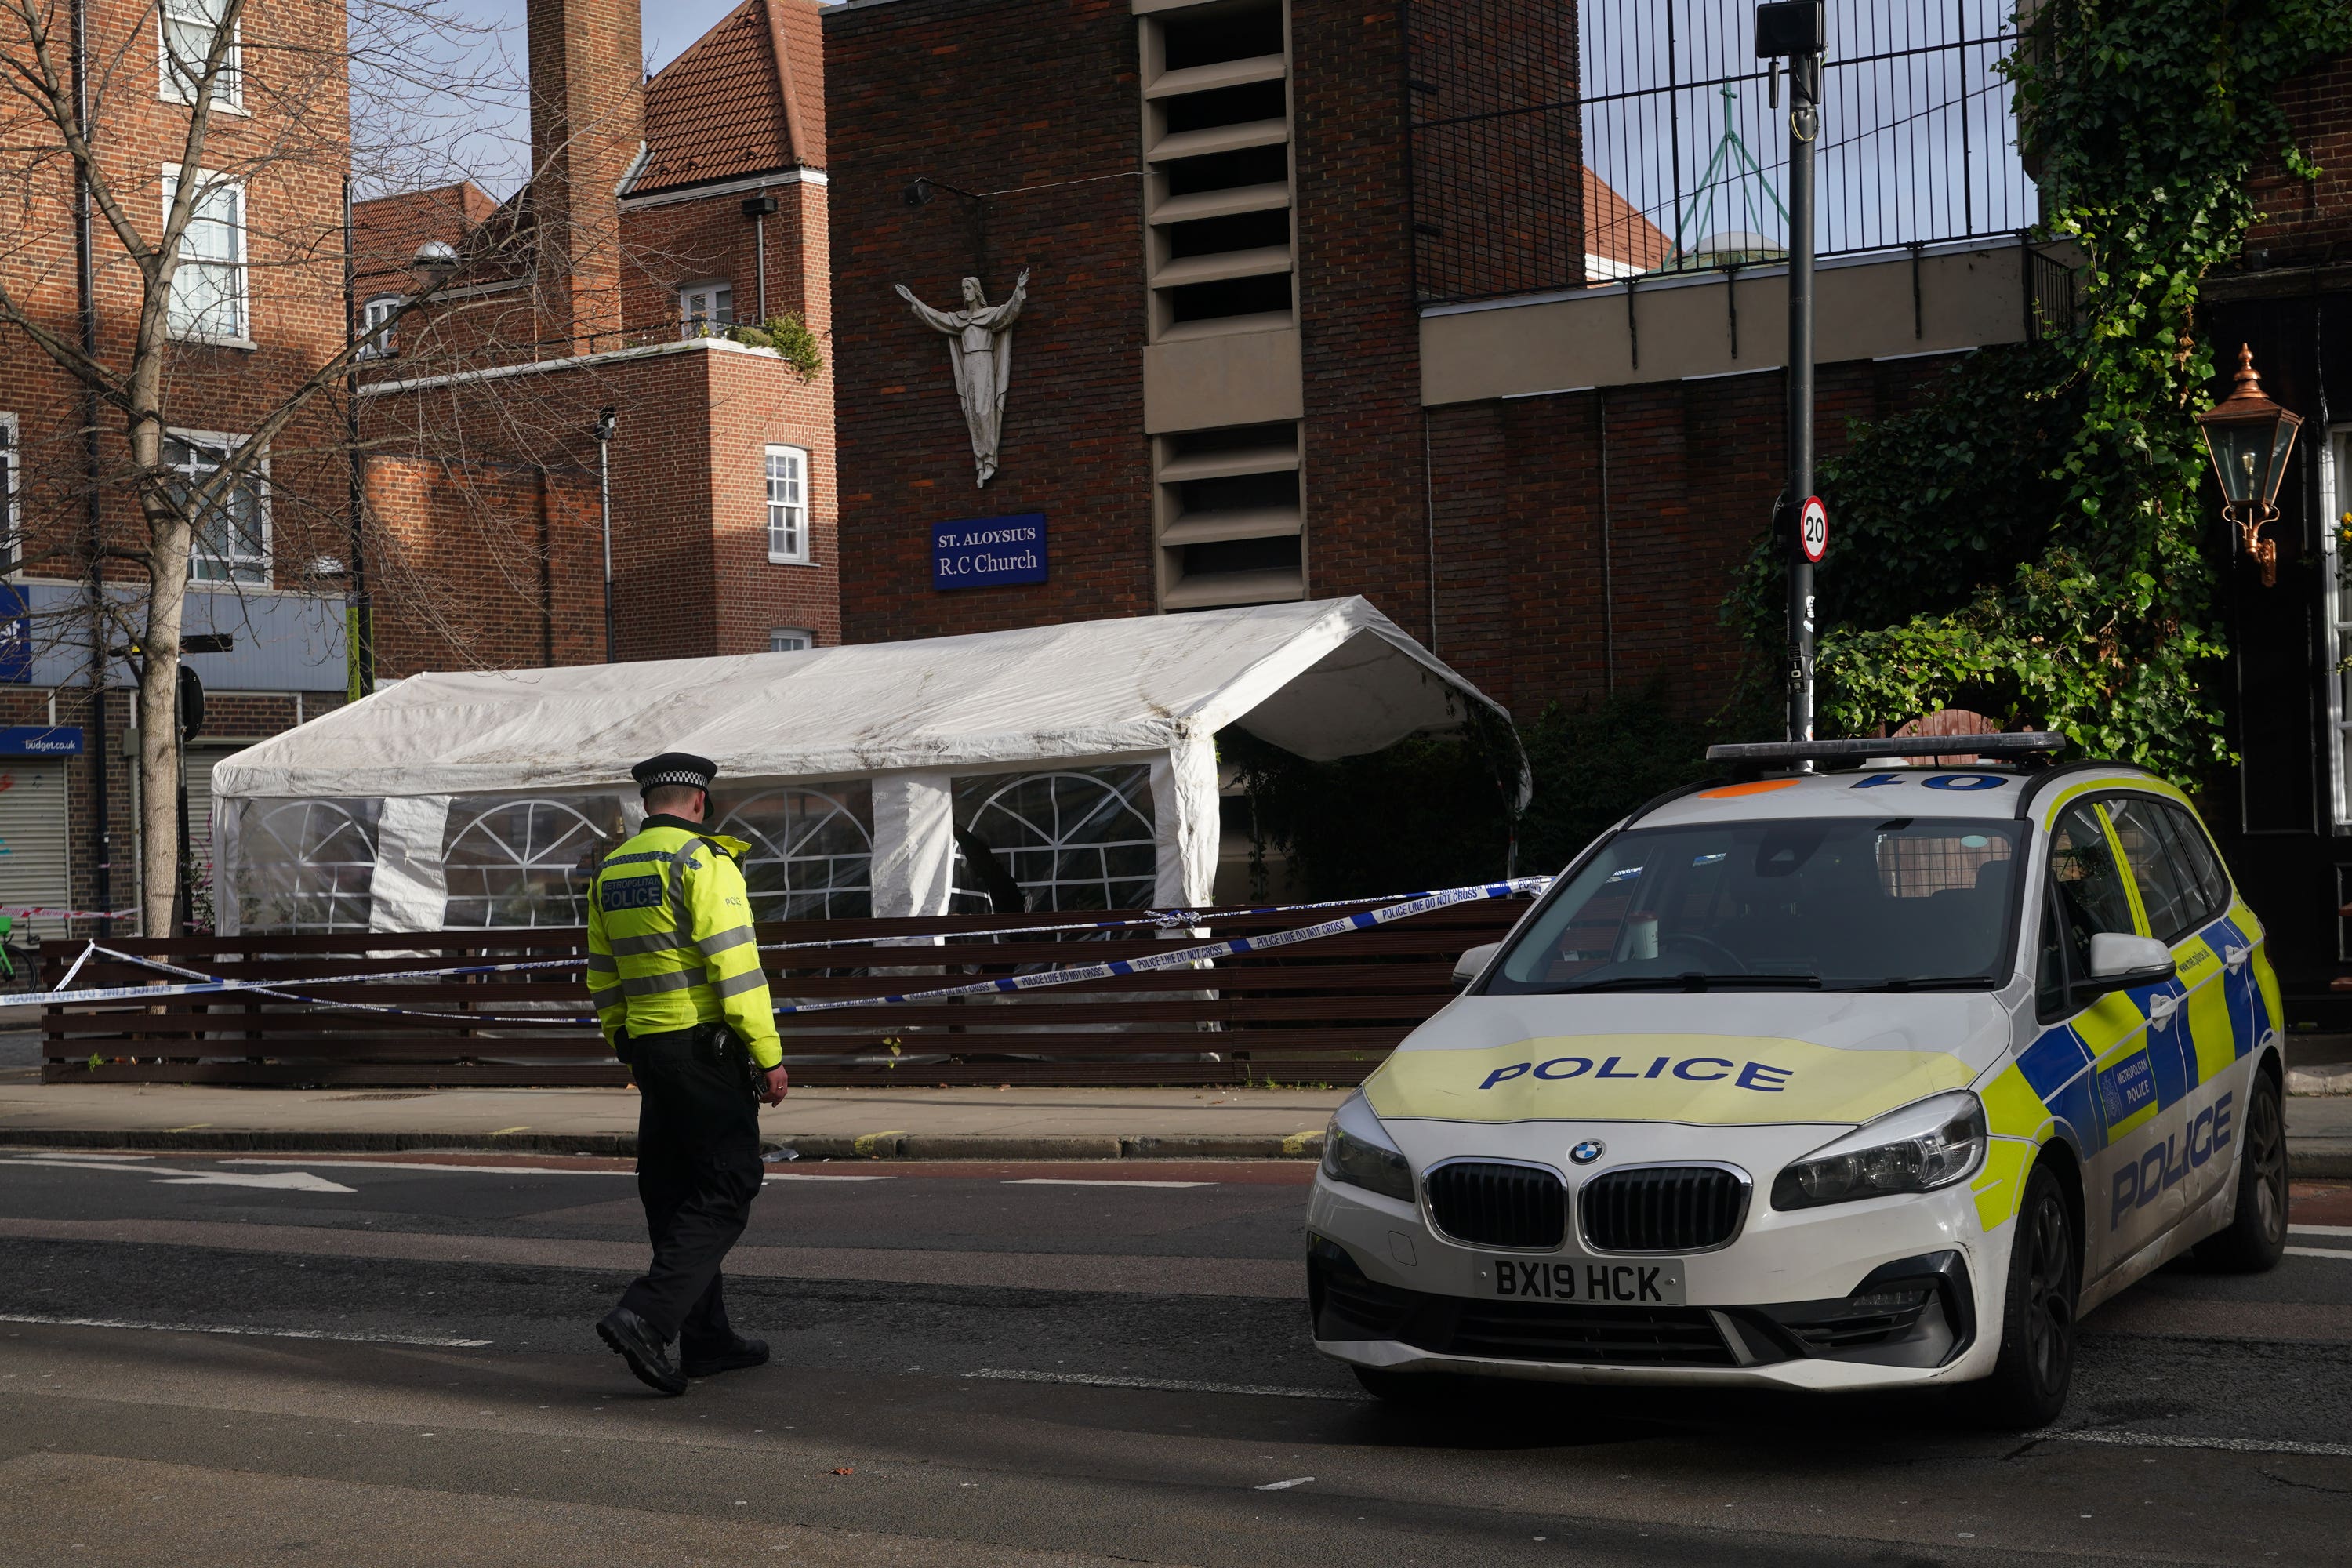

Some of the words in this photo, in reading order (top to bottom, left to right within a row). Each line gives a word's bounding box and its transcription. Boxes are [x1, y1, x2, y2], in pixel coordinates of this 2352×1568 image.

[938, 535, 960, 547] ST.
[963, 528, 1036, 546] ALOYSIUS
[1806, 516, 1824, 543] 20
[939, 555, 971, 576] R.C
[975, 549, 1038, 573] Church
[26, 740, 75, 752] budget.co.uk
[602, 877, 661, 890] METROPOLITAN
[602, 887, 661, 909] POLICE
[1382, 905, 1408, 920] POLICE
[1408, 901, 1425, 913] LINE
[1425, 897, 1436, 909] DO
[1437, 894, 1451, 906] NOT
[1453, 890, 1478, 902] CROSS
[1256, 934, 1279, 947] POLICE
[1279, 931, 1297, 943] LINE
[1296, 930, 1307, 940] DO
[1307, 927, 1322, 938] NOT
[1321, 920, 1346, 935] CROSS
[1136, 957, 1161, 969] POLICE
[1161, 954, 1177, 966] LINE
[1178, 952, 1187, 962] DO
[1187, 949, 1201, 960] NOT
[1201, 945, 1223, 956] CROSS
[1021, 975, 1044, 986] POLICE
[1044, 972, 1059, 983] LINE
[1059, 971, 1069, 982] DO
[1069, 969, 1083, 980] NOT
[1083, 967, 1105, 978] CROSS
[1479, 1056, 1795, 1093] POLICE
[2117, 1058, 2149, 1085] METROPOLITAN
[2126, 1079, 2150, 1104] POLICE
[2111, 1090, 2233, 1232] POLICE
[1494, 1260, 1576, 1298] BX19
[1586, 1265, 1662, 1301] HCK
